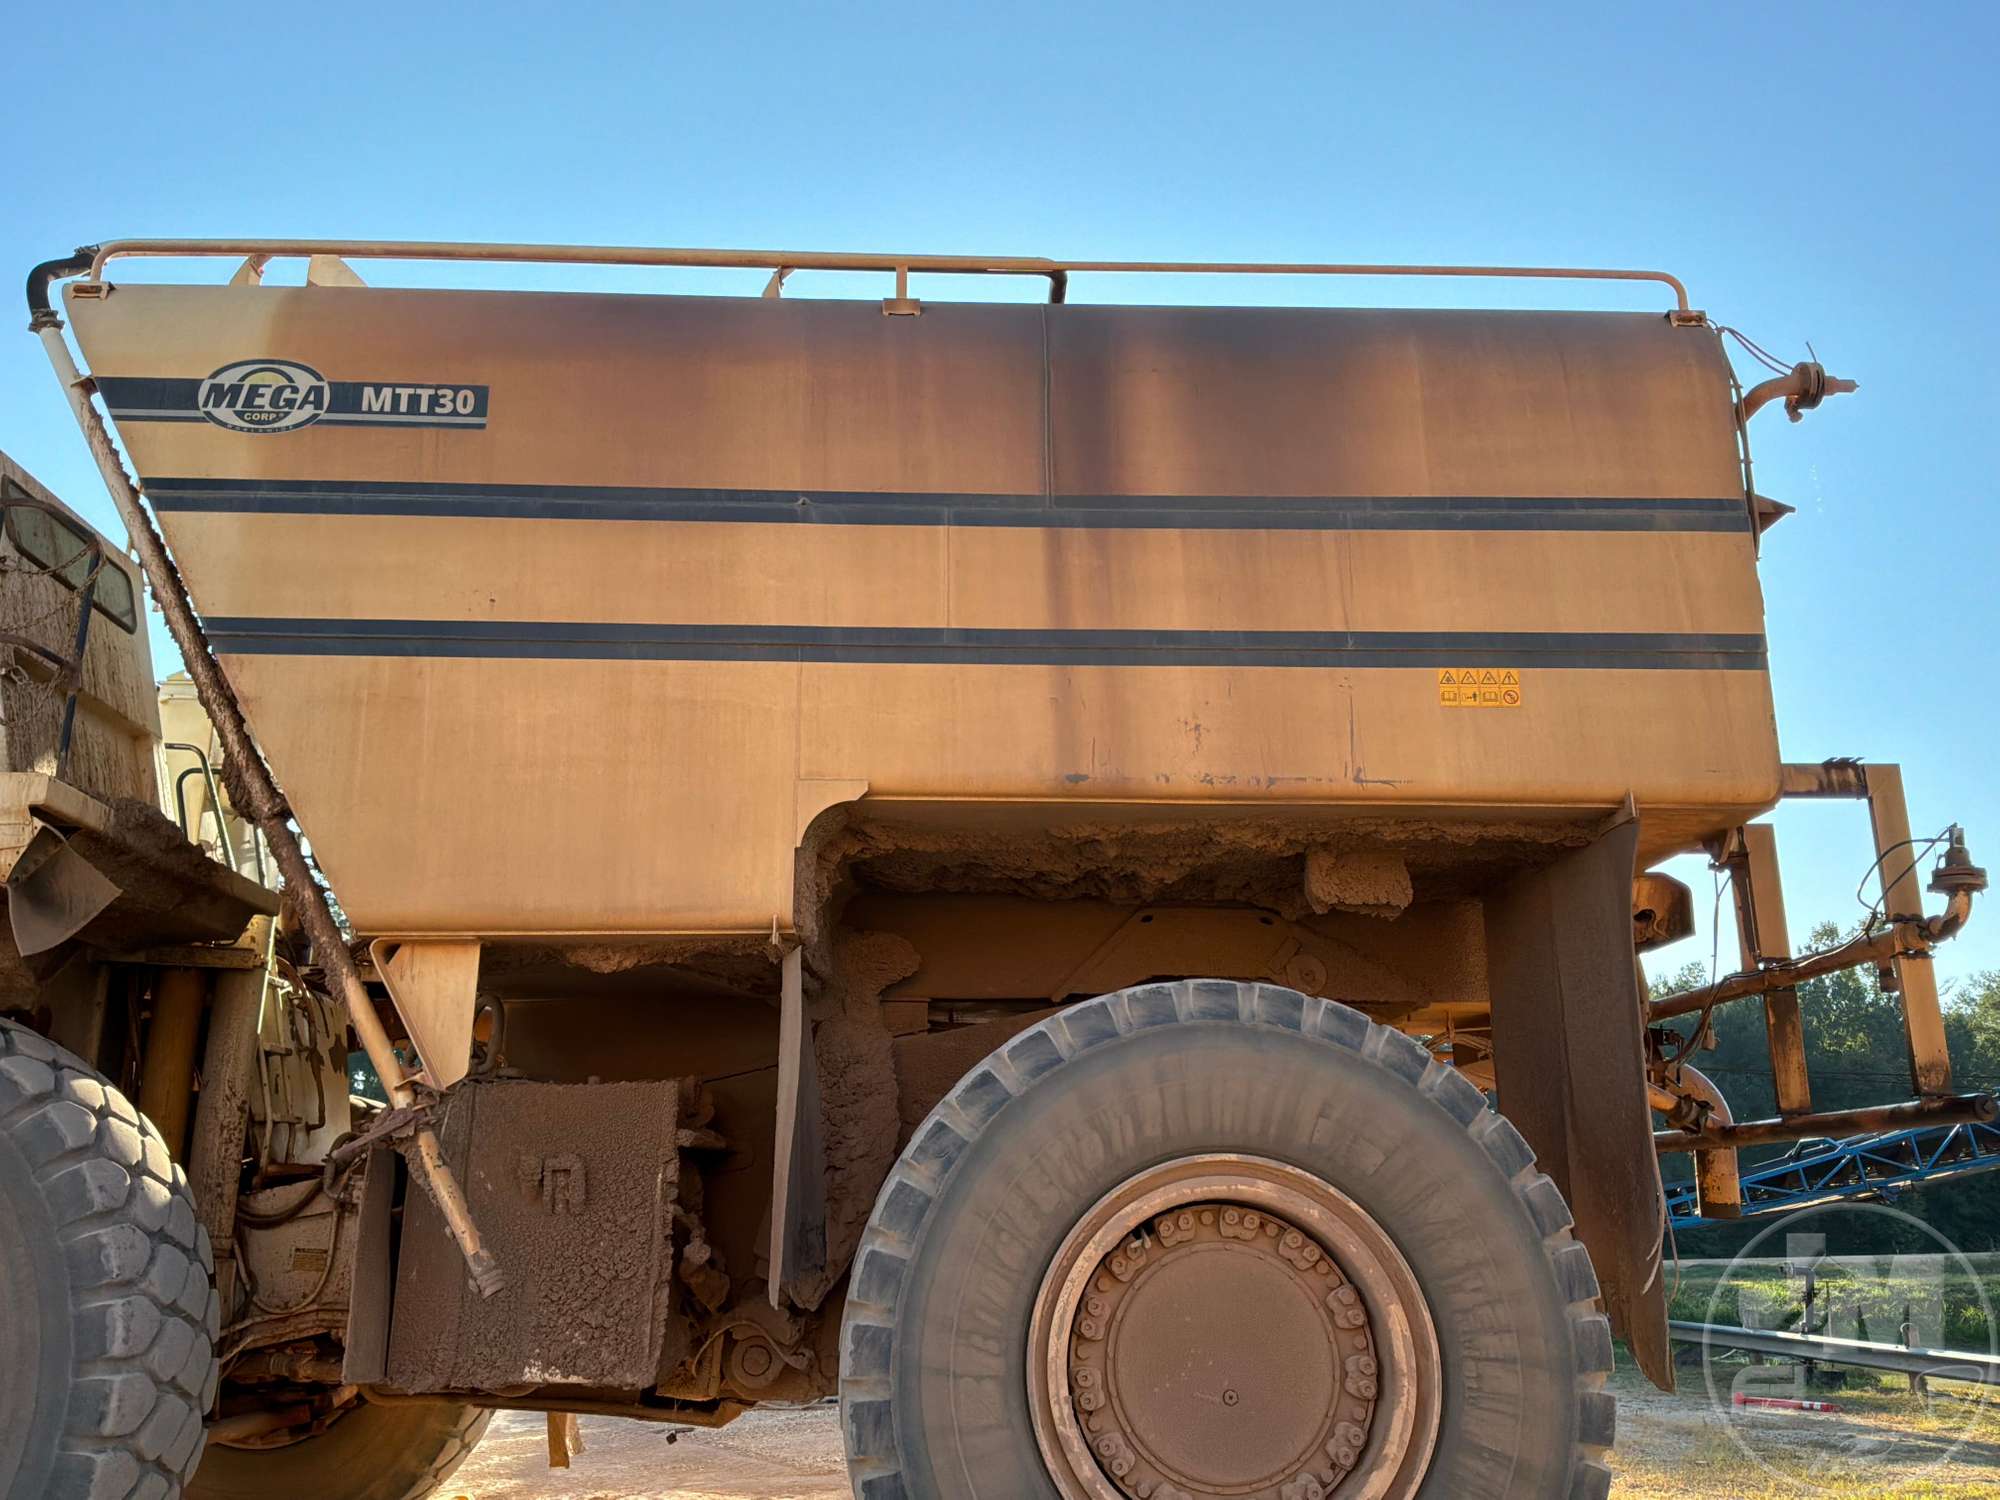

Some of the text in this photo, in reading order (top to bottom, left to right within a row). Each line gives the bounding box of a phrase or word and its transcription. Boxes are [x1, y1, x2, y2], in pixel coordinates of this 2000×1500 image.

[202, 383, 324, 410] MEGA
[361, 387, 475, 414] MTT30
[243, 412, 277, 421] CORP
